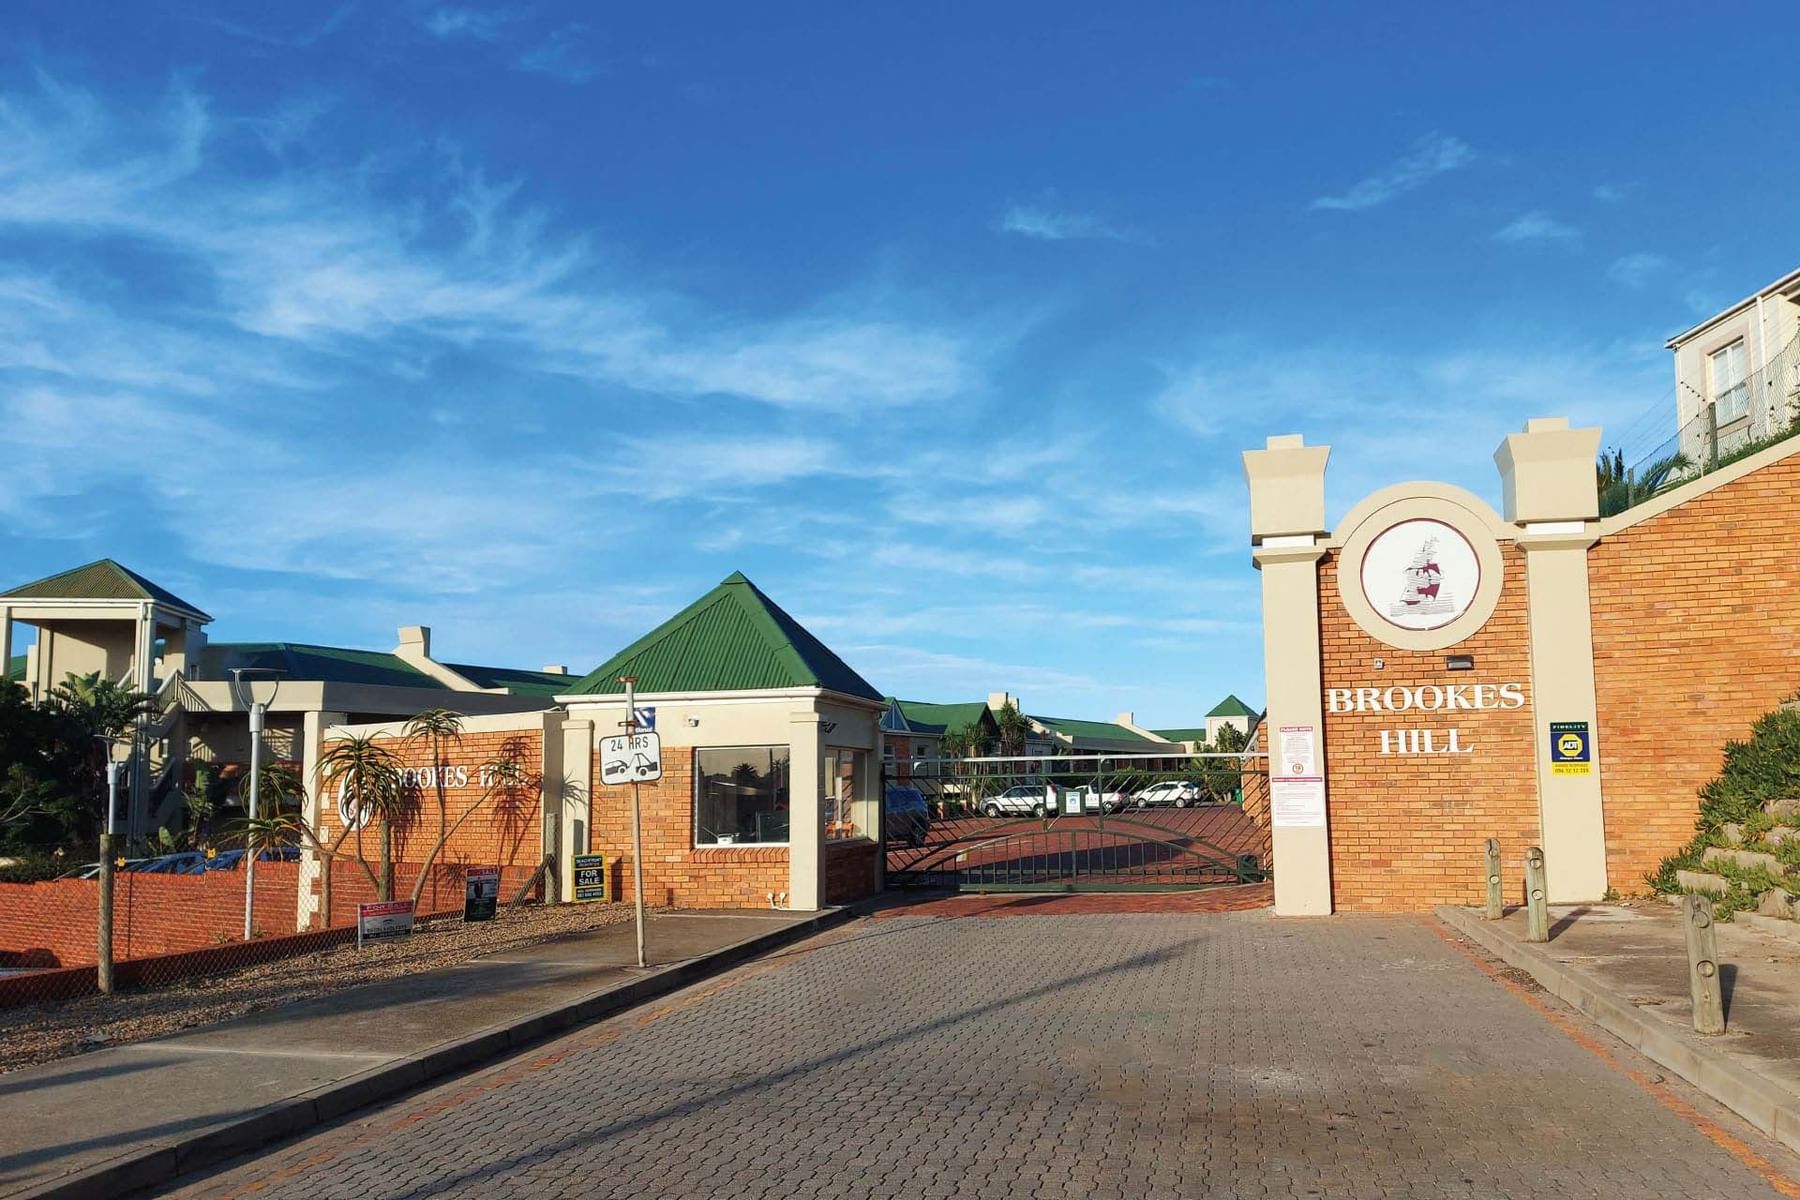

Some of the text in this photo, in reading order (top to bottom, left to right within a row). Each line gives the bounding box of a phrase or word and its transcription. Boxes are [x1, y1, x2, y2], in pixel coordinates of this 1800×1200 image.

[1328, 683, 1525, 713] BROOKES
[610, 736, 649, 752] 24 HRS
[1379, 728, 1475, 755] HILL
[1563, 741, 1578, 750] ADT
[580, 869, 598, 878] FOR
[578, 876, 601, 886] SALE
